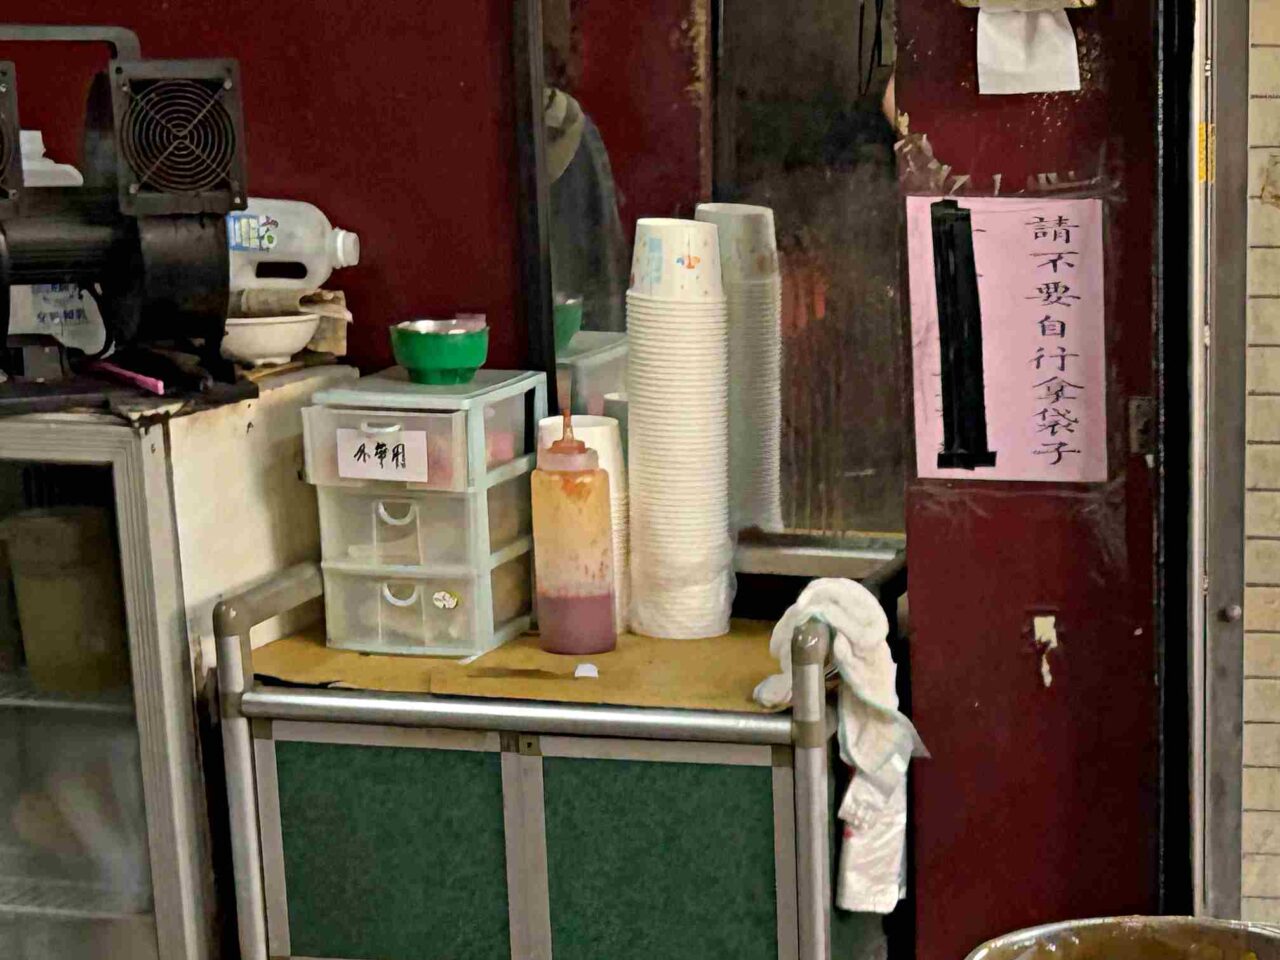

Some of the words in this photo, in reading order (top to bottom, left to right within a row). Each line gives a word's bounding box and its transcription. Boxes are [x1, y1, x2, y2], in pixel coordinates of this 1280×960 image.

[1024, 214, 1085, 466] 請不要自行拿袋子
